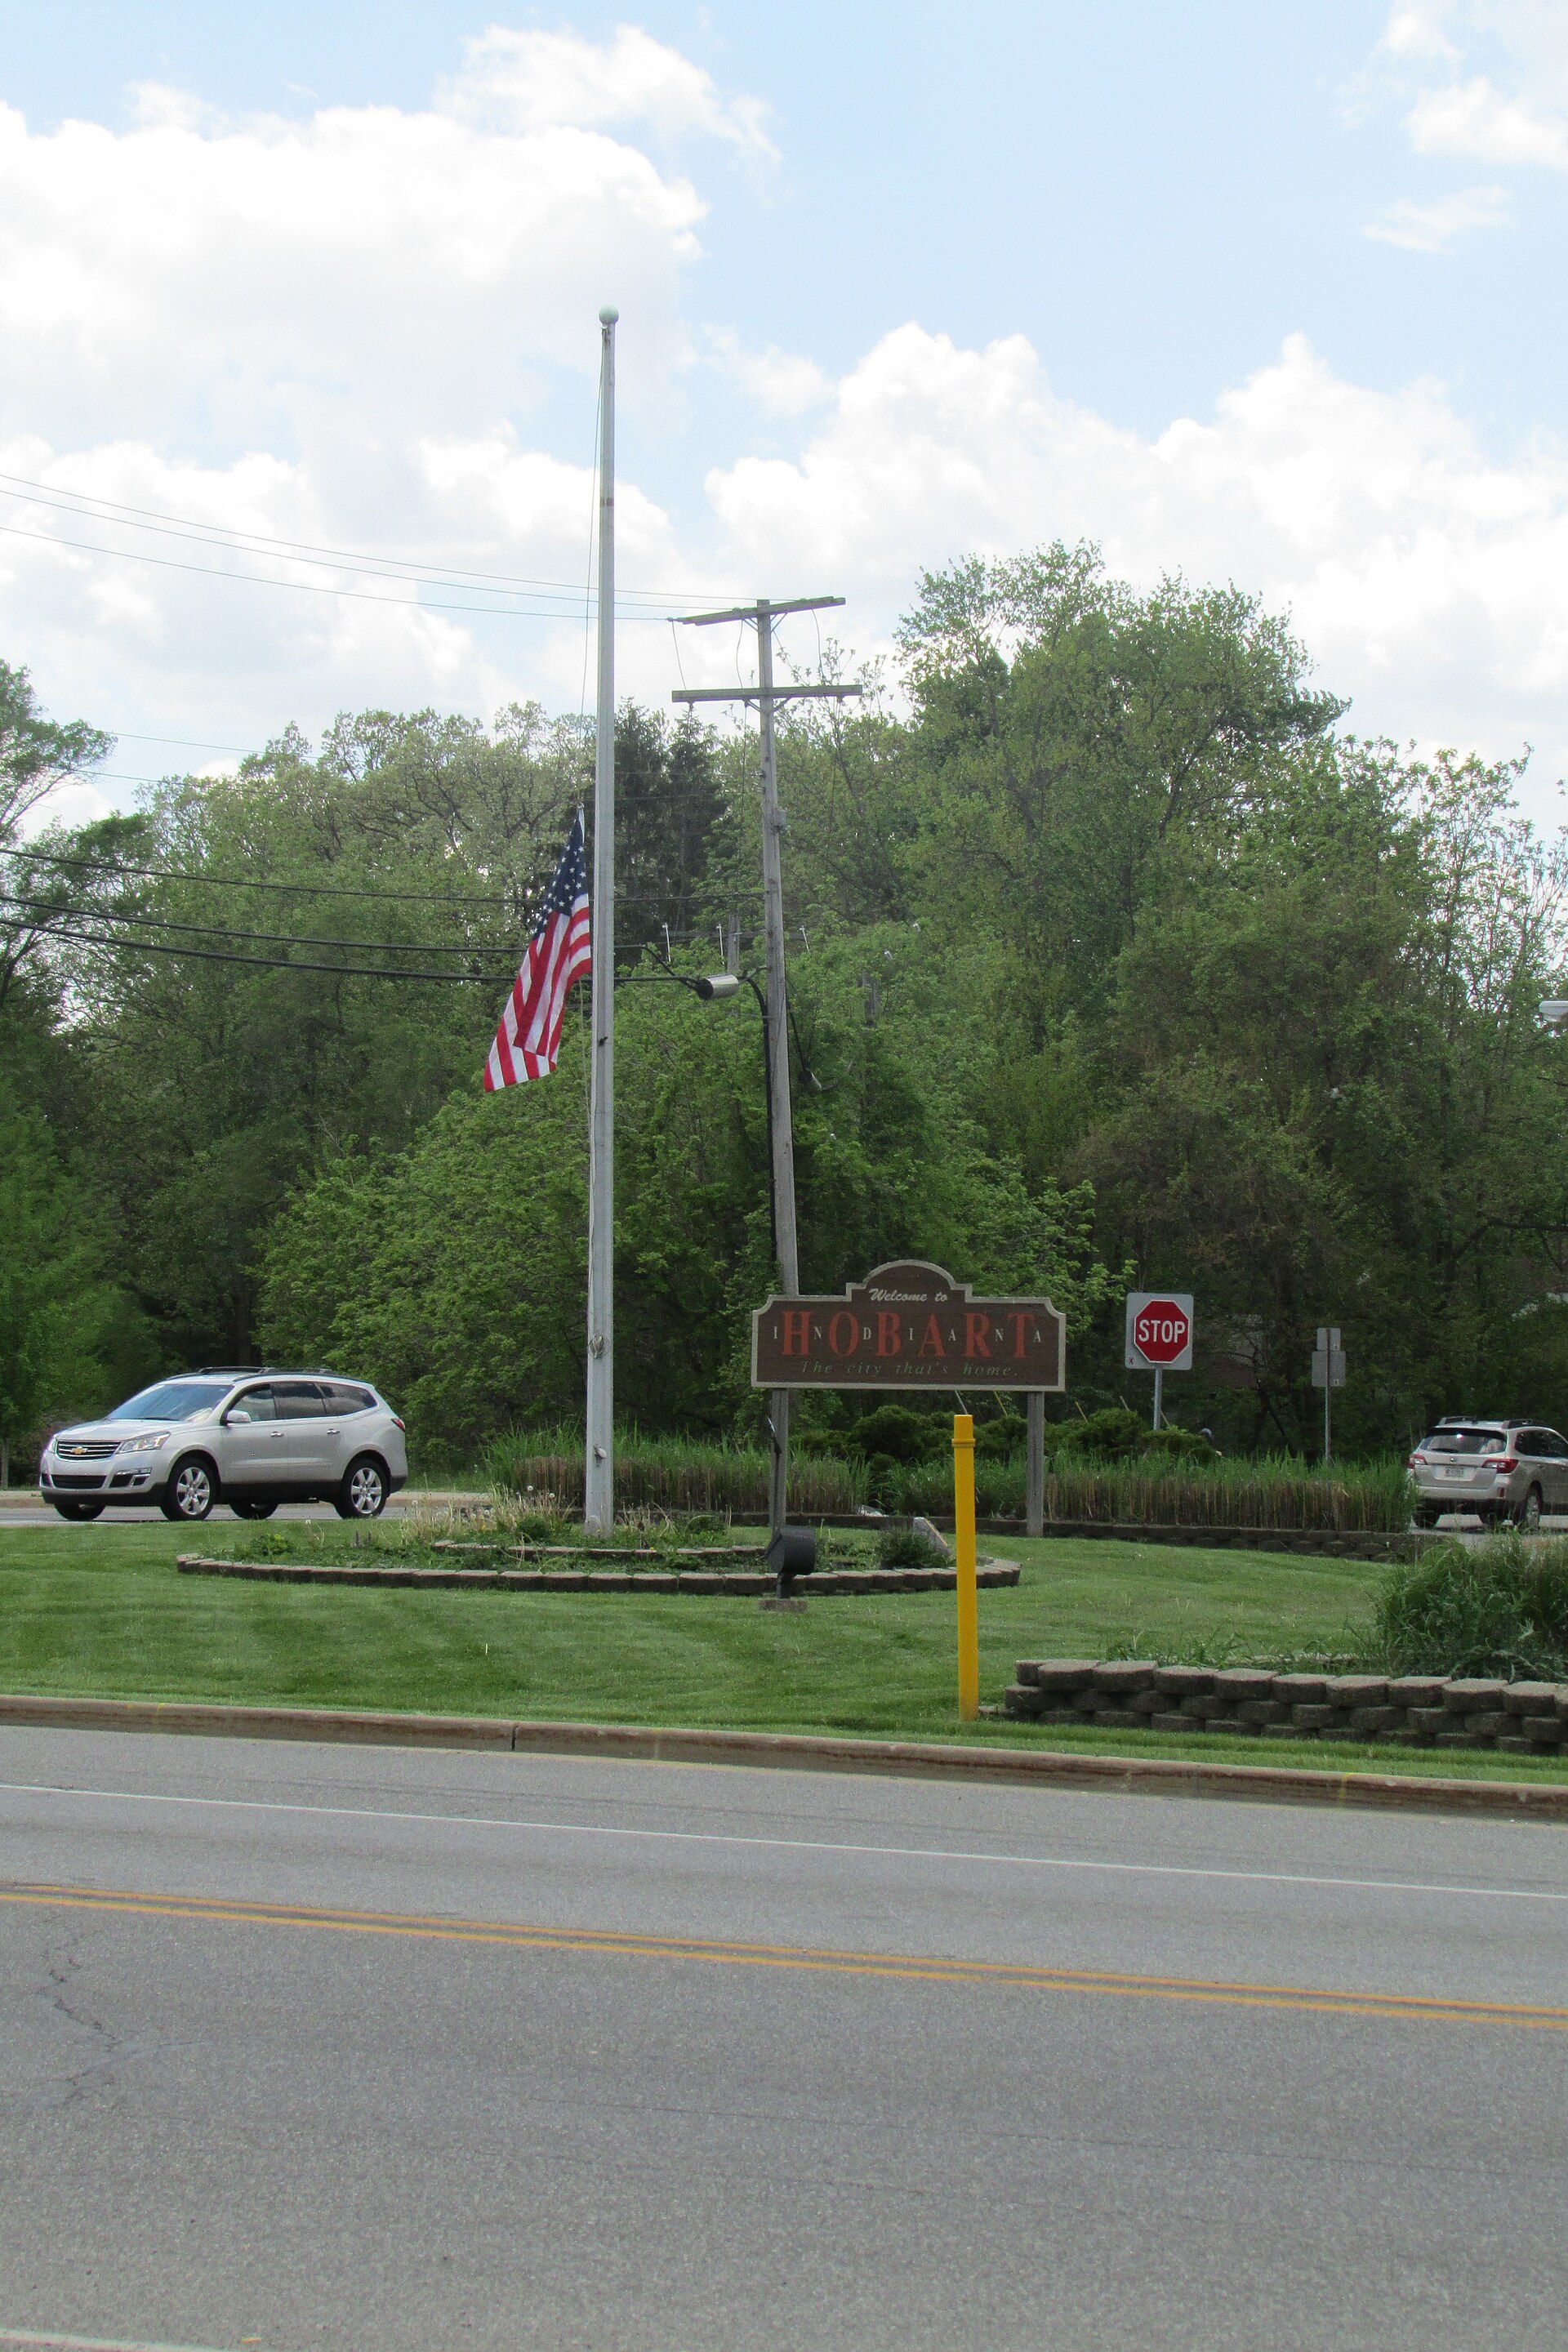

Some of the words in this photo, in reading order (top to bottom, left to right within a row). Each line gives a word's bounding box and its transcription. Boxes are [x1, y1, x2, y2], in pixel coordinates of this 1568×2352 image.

[868, 1288, 928, 1302] Welcome
[934, 1291, 948, 1303] to
[781, 1310, 1035, 1360] HOBART
[1138, 1319, 1186, 1343] STOP
[801, 1361, 833, 1374] The
[847, 1361, 882, 1378] city
[895, 1361, 949, 1374] that's
[962, 1362, 1019, 1377] home.
